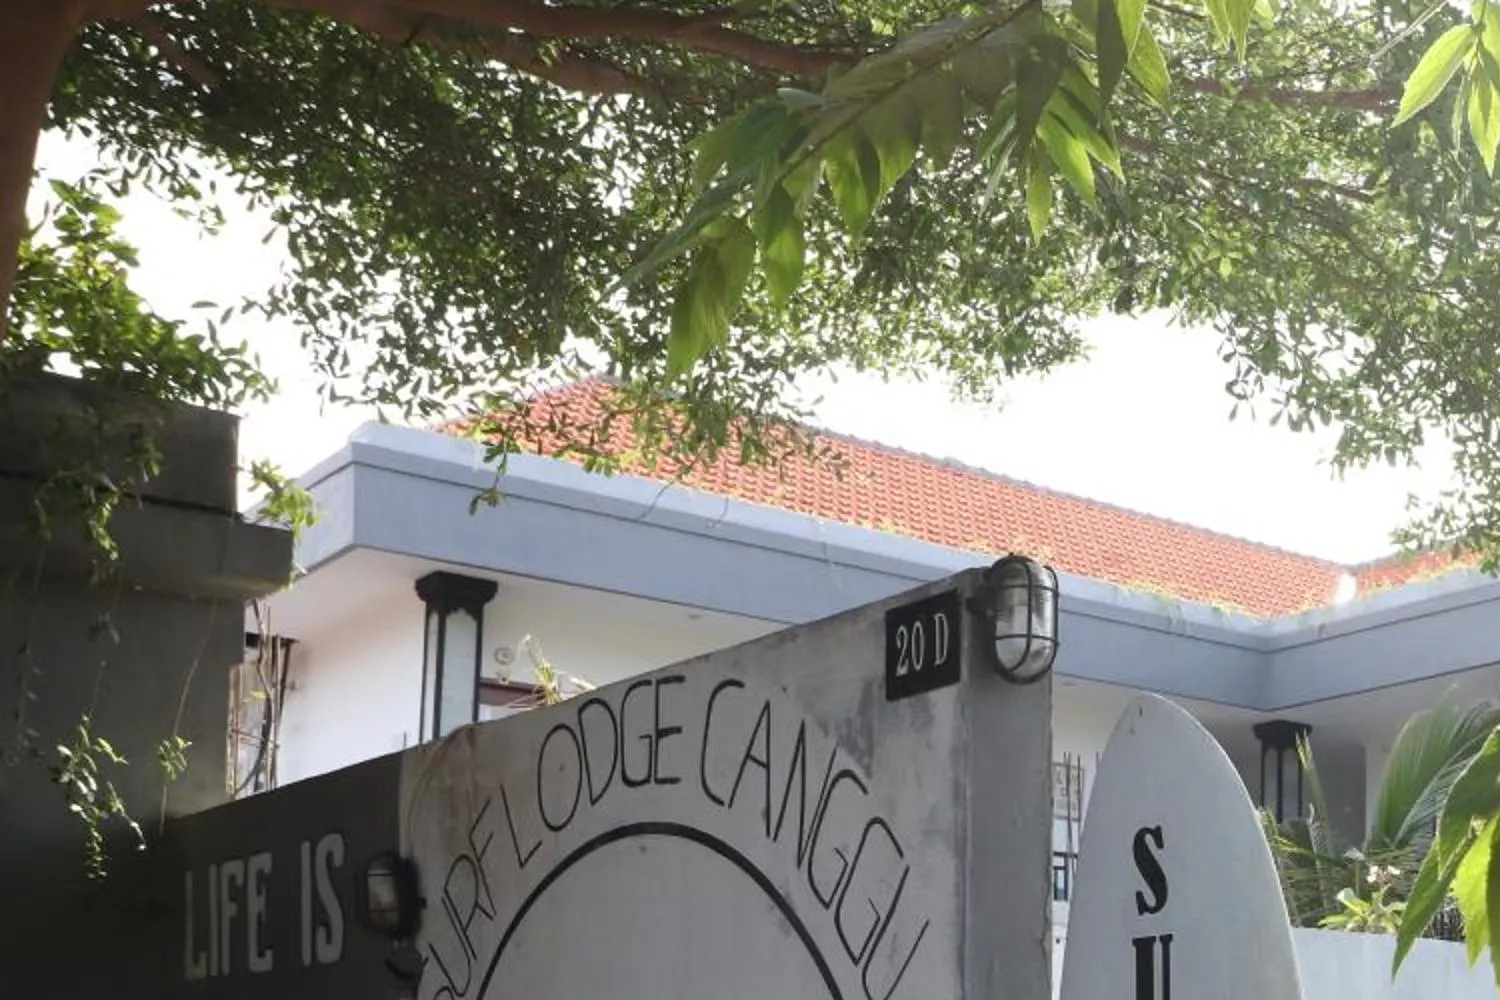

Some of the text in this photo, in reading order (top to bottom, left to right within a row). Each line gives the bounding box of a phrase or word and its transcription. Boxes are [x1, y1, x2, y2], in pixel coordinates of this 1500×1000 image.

[896, 613, 949, 676] 20 D
[184, 833, 345, 981] LIFE IS
